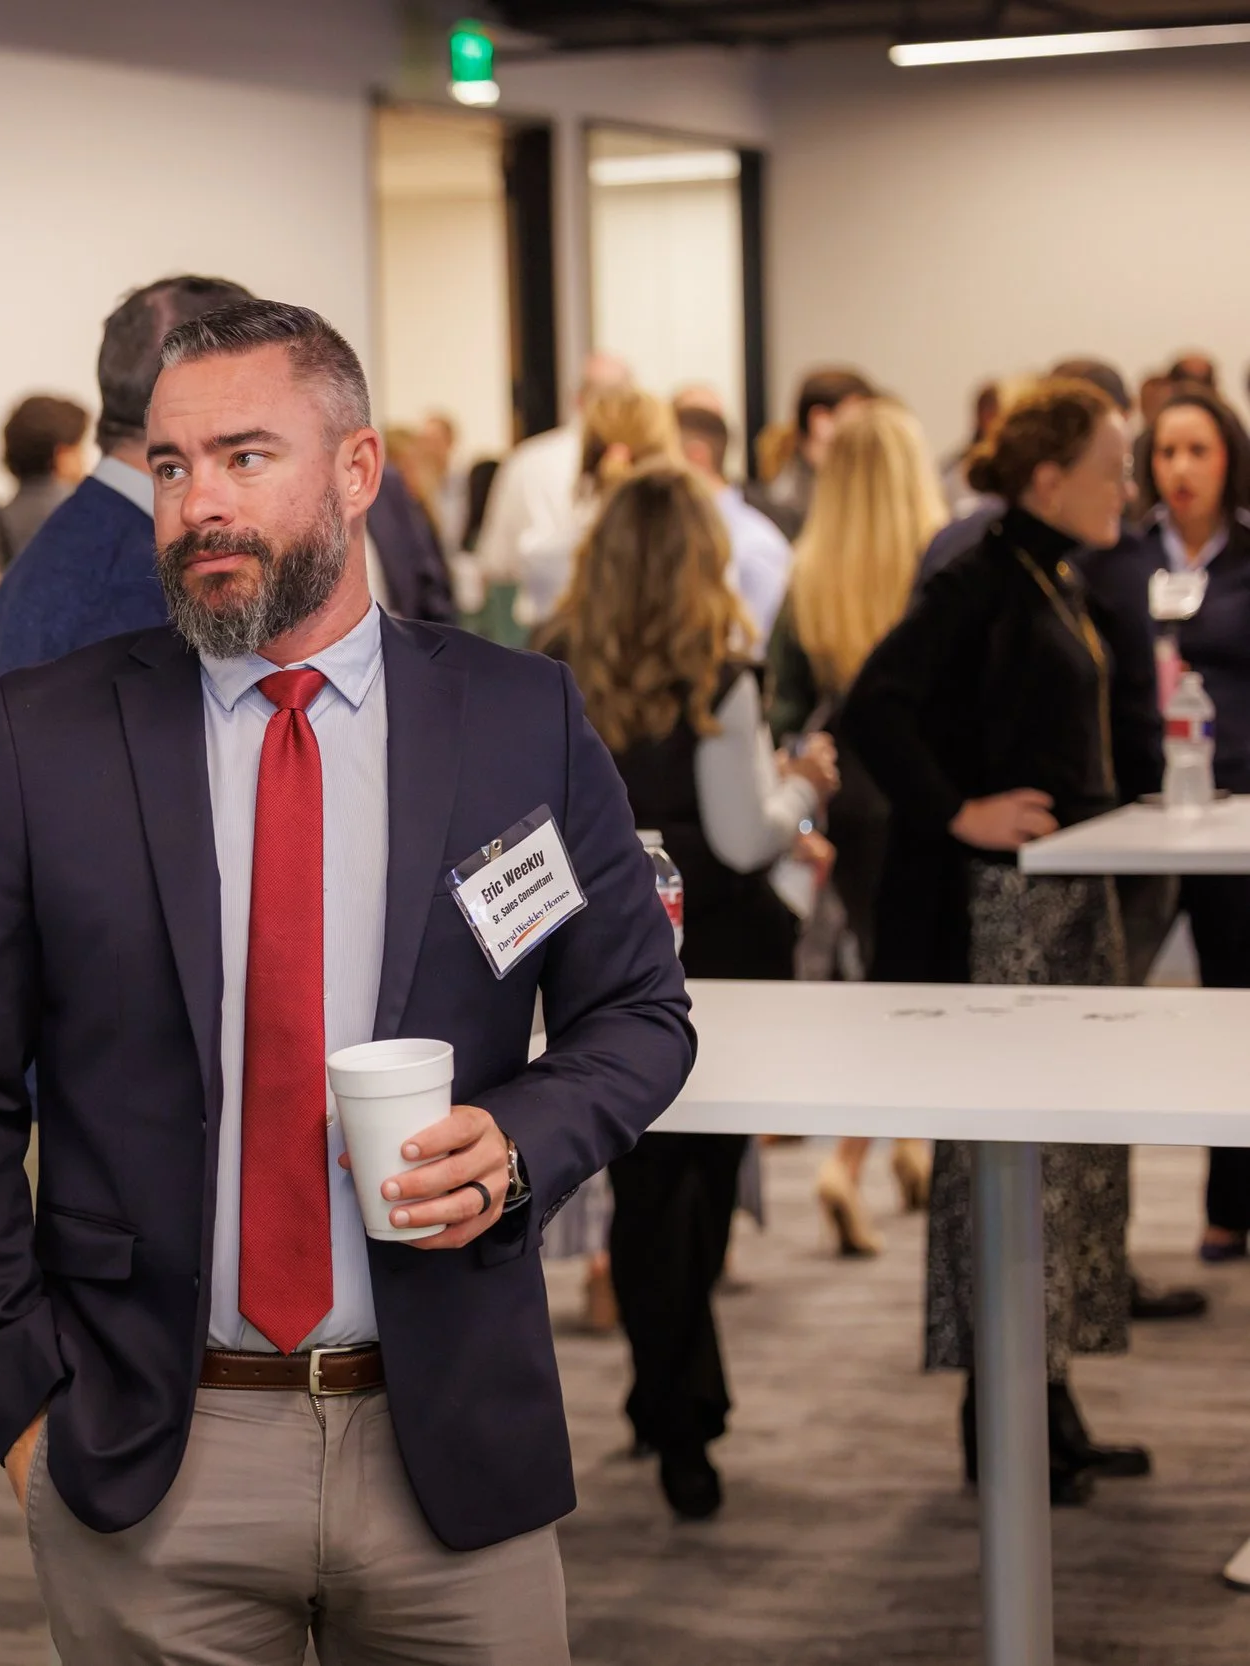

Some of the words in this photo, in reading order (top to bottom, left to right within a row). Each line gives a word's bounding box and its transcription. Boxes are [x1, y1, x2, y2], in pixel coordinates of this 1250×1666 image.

[480, 880, 504, 905] Eric
[502, 850, 546, 888] Weekly
[492, 911, 503, 925] Sr.
[501, 897, 519, 918] Sales
[517, 871, 554, 904] Consultant
[497, 930, 518, 952] David
[515, 908, 545, 935] Weekley
[543, 889, 570, 912] Homes
